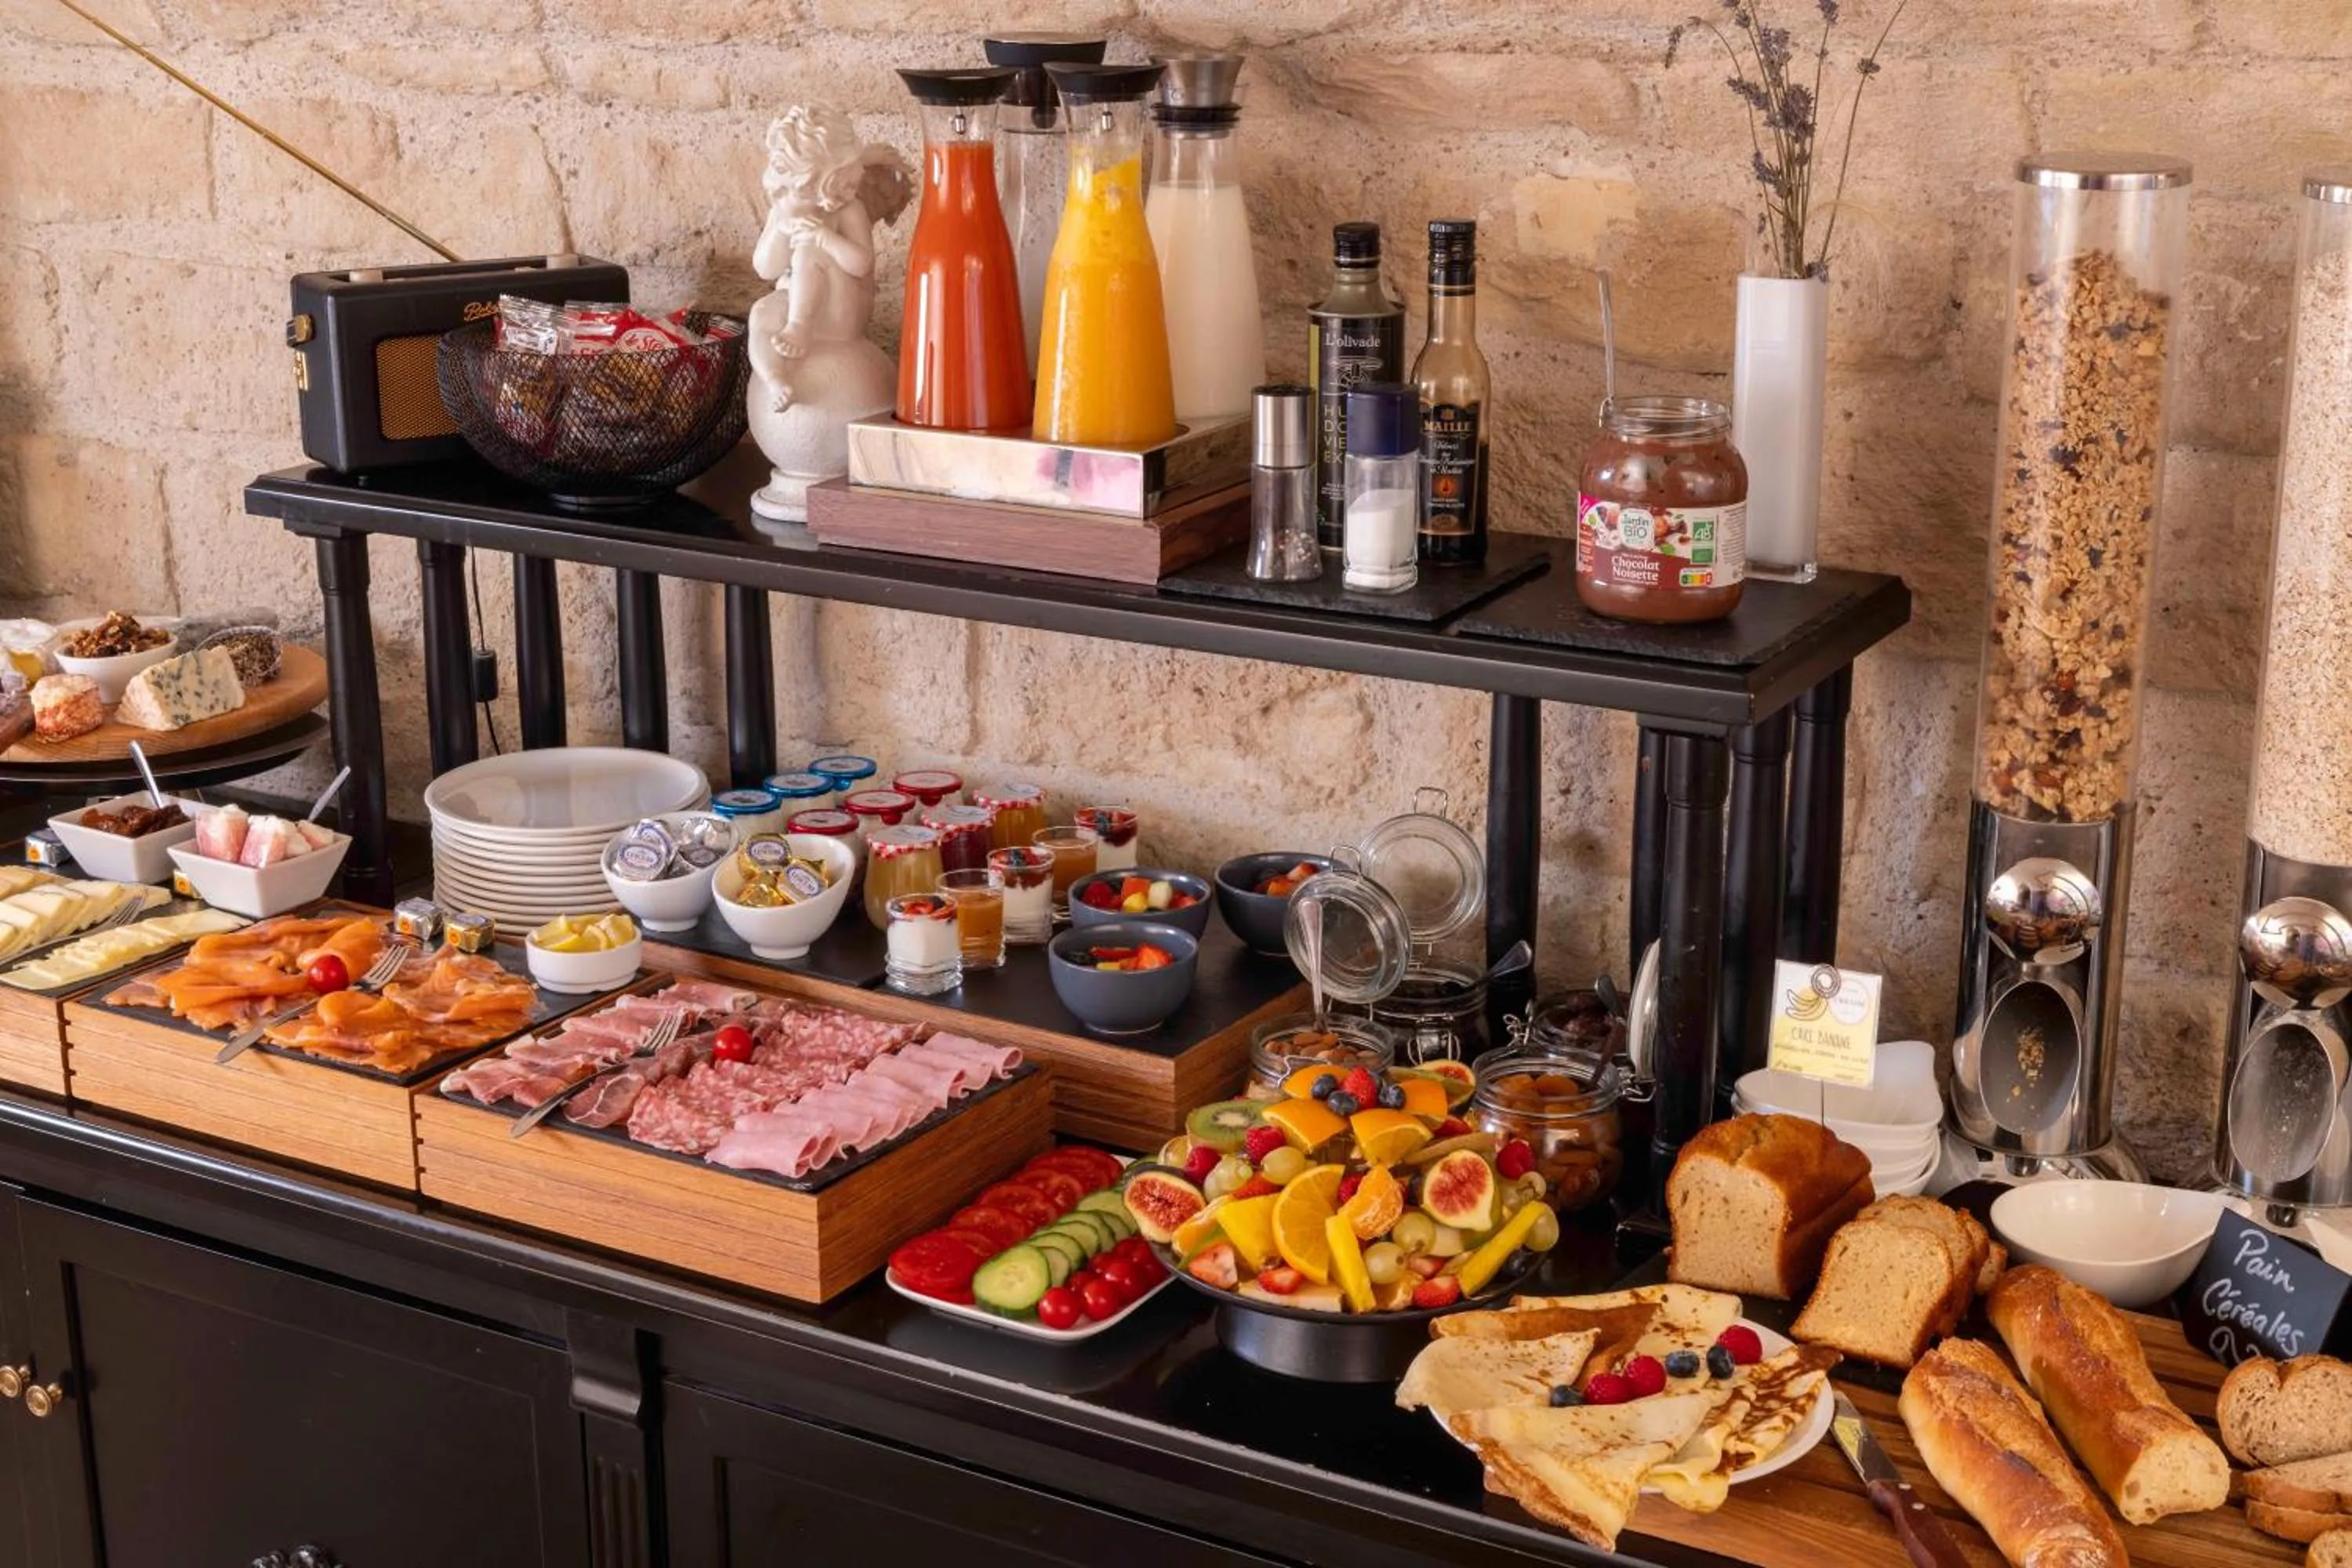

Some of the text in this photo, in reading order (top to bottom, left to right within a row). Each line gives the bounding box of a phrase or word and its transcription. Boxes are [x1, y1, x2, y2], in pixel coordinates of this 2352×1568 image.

[1326, 332, 1381, 347] L'olivade
[1621, 514, 1650, 527] Jardin
[1611, 555, 1660, 572] Chocolat
[1613, 565, 1659, 581] Noisette
[1791, 1026, 1852, 1051] CAKE BANANE
[2233, 1229, 2296, 1294] Pain
[2201, 1278, 2305, 1357] Céréales
